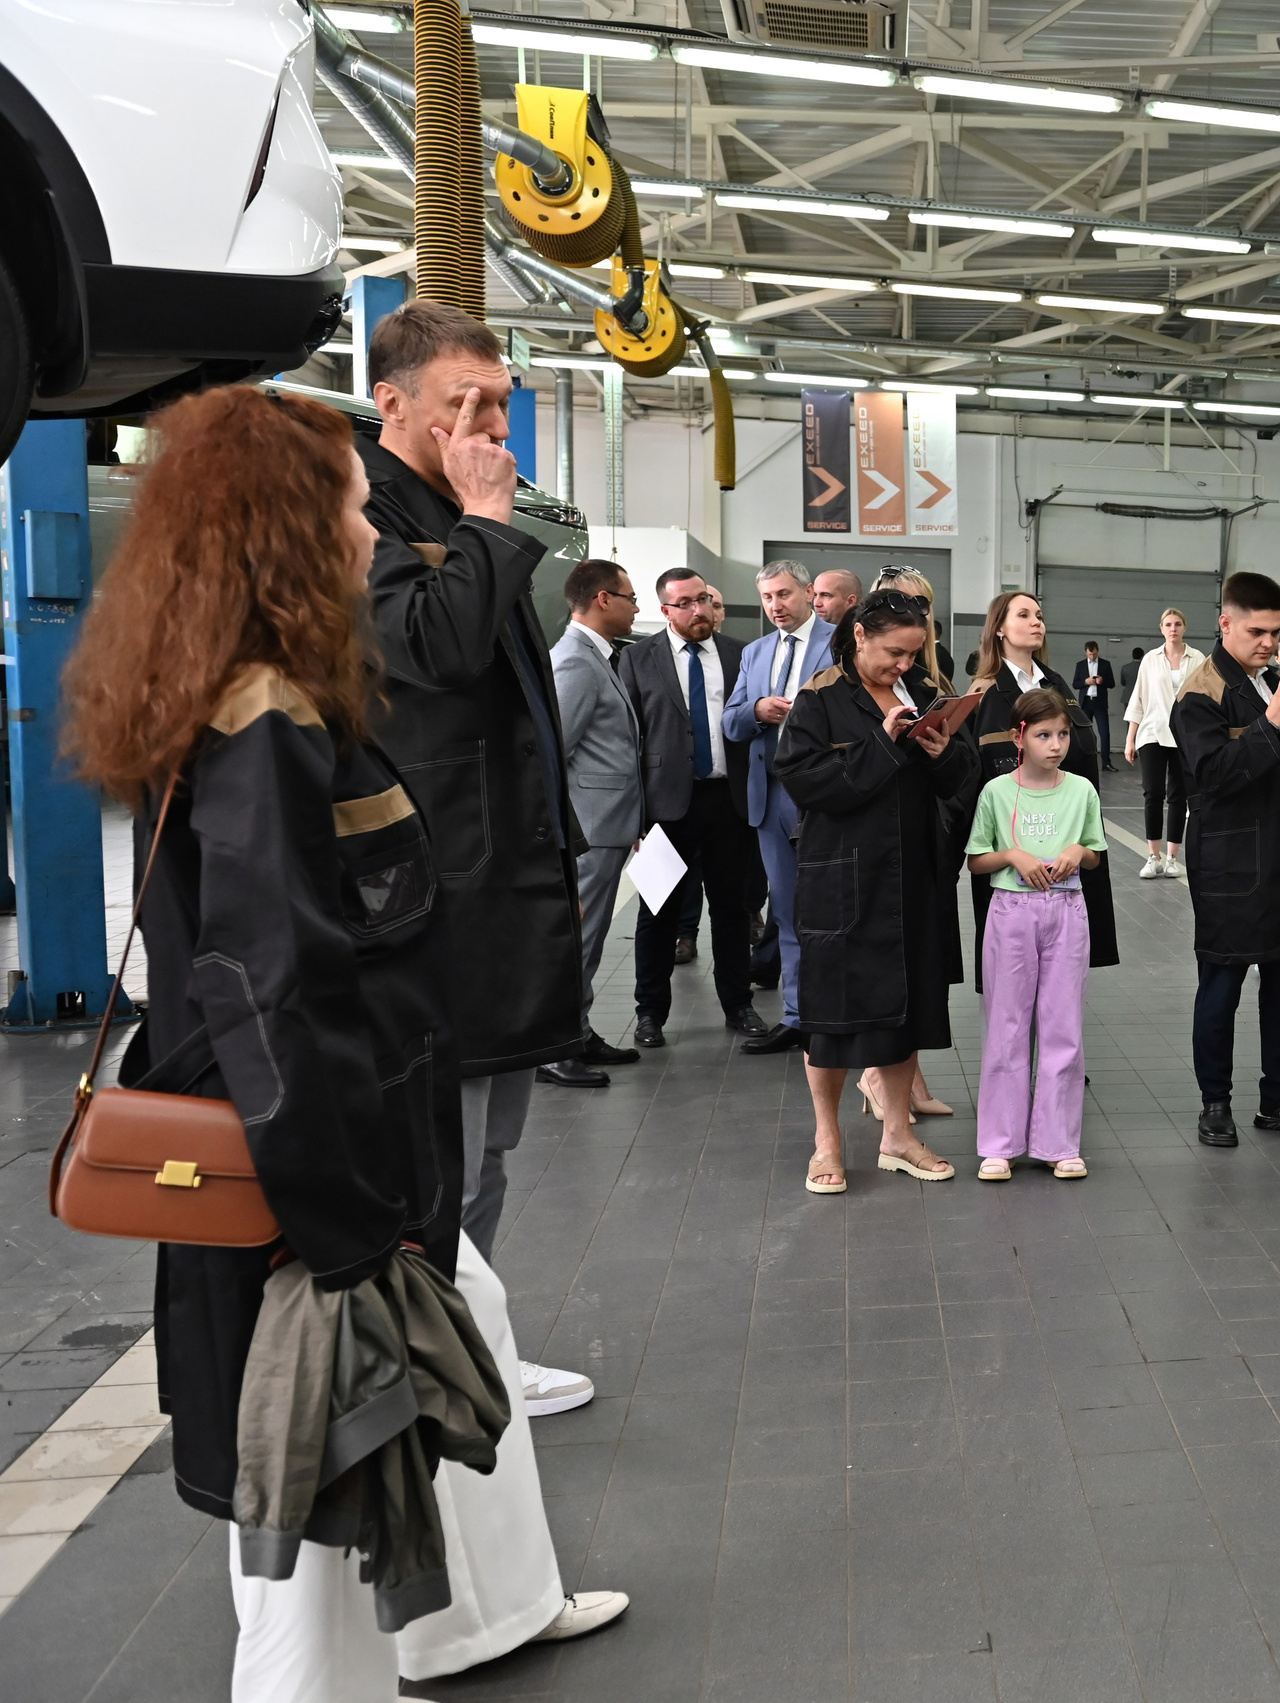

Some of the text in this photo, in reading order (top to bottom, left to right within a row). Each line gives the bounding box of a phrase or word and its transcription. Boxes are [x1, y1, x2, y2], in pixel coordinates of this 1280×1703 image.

[805, 403, 814, 465] EXEED
[859, 407, 869, 468] EXEED
[807, 521, 847, 530] SERVICE
[862, 524, 902, 532] SERVICE
[915, 524, 954, 532] SERVICE
[1022, 813, 1055, 825] NEXT
[1021, 825, 1059, 837] LEVEL
